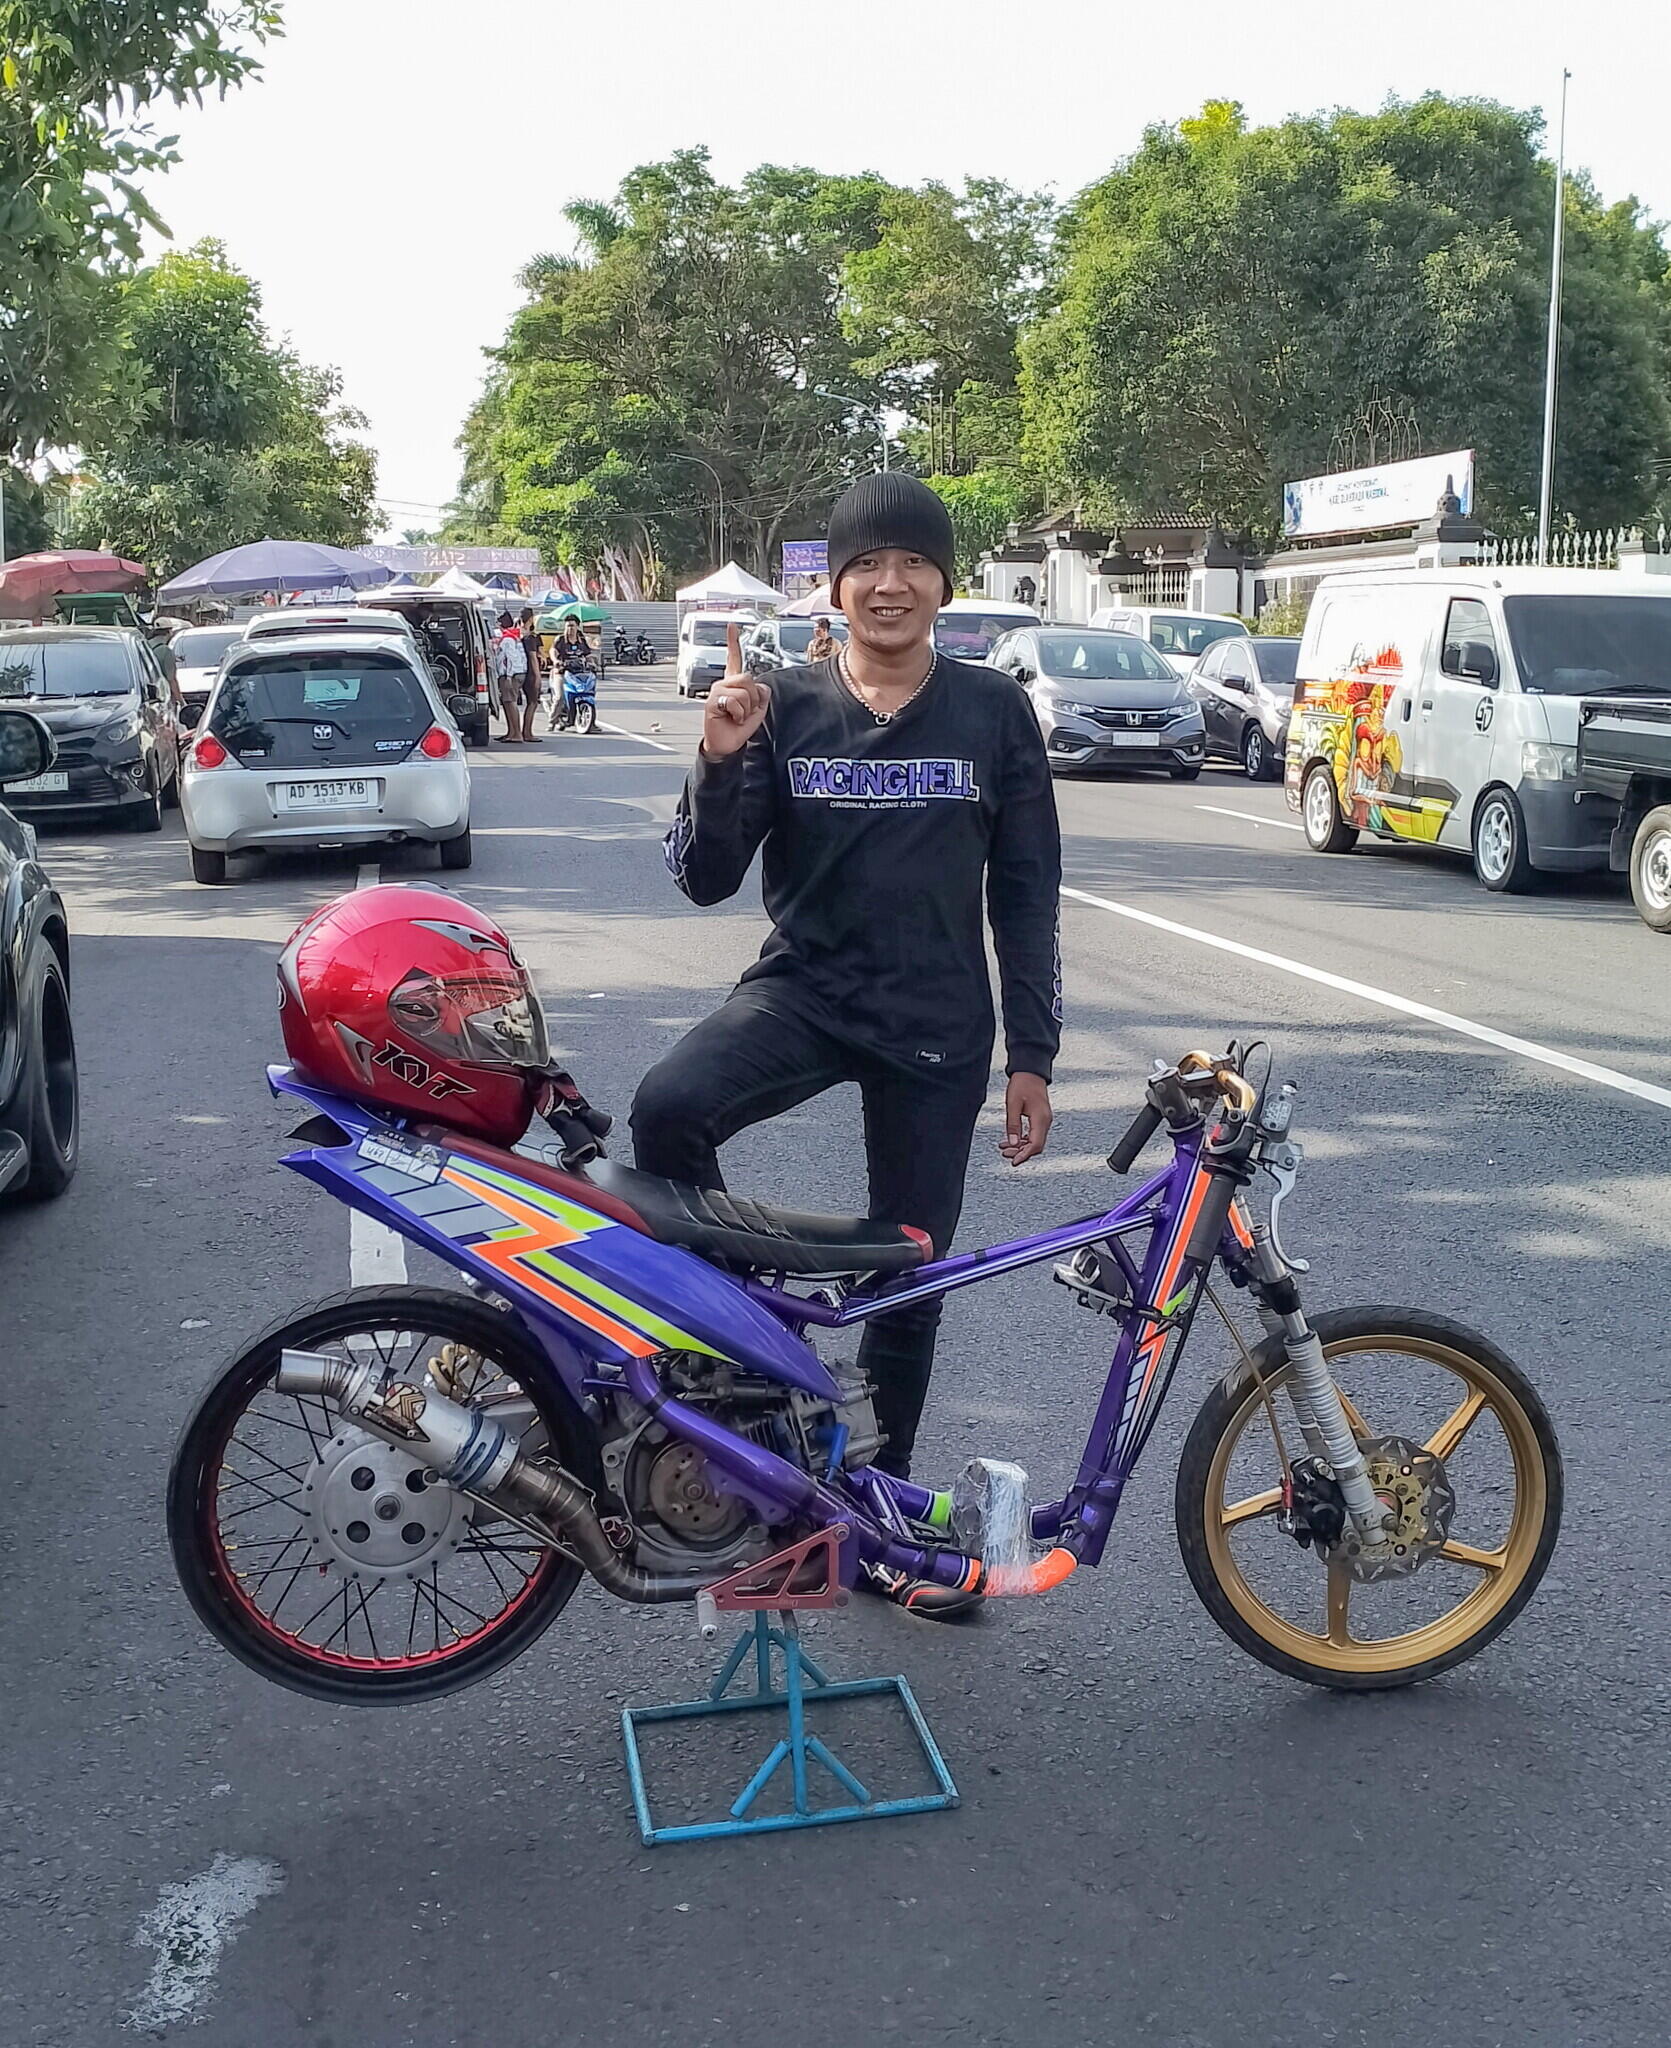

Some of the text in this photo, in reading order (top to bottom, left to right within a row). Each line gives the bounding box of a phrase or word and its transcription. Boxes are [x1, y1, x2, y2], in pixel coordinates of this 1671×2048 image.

[54, 774, 66, 785] GT
[788, 757, 980, 802] RACINGHELL
[290, 781, 365, 798] AD 1513 KB
[829, 801, 868, 809] ORIGINAL
[869, 801, 899, 809] RACING
[372, 1039, 478, 1100] KYT
